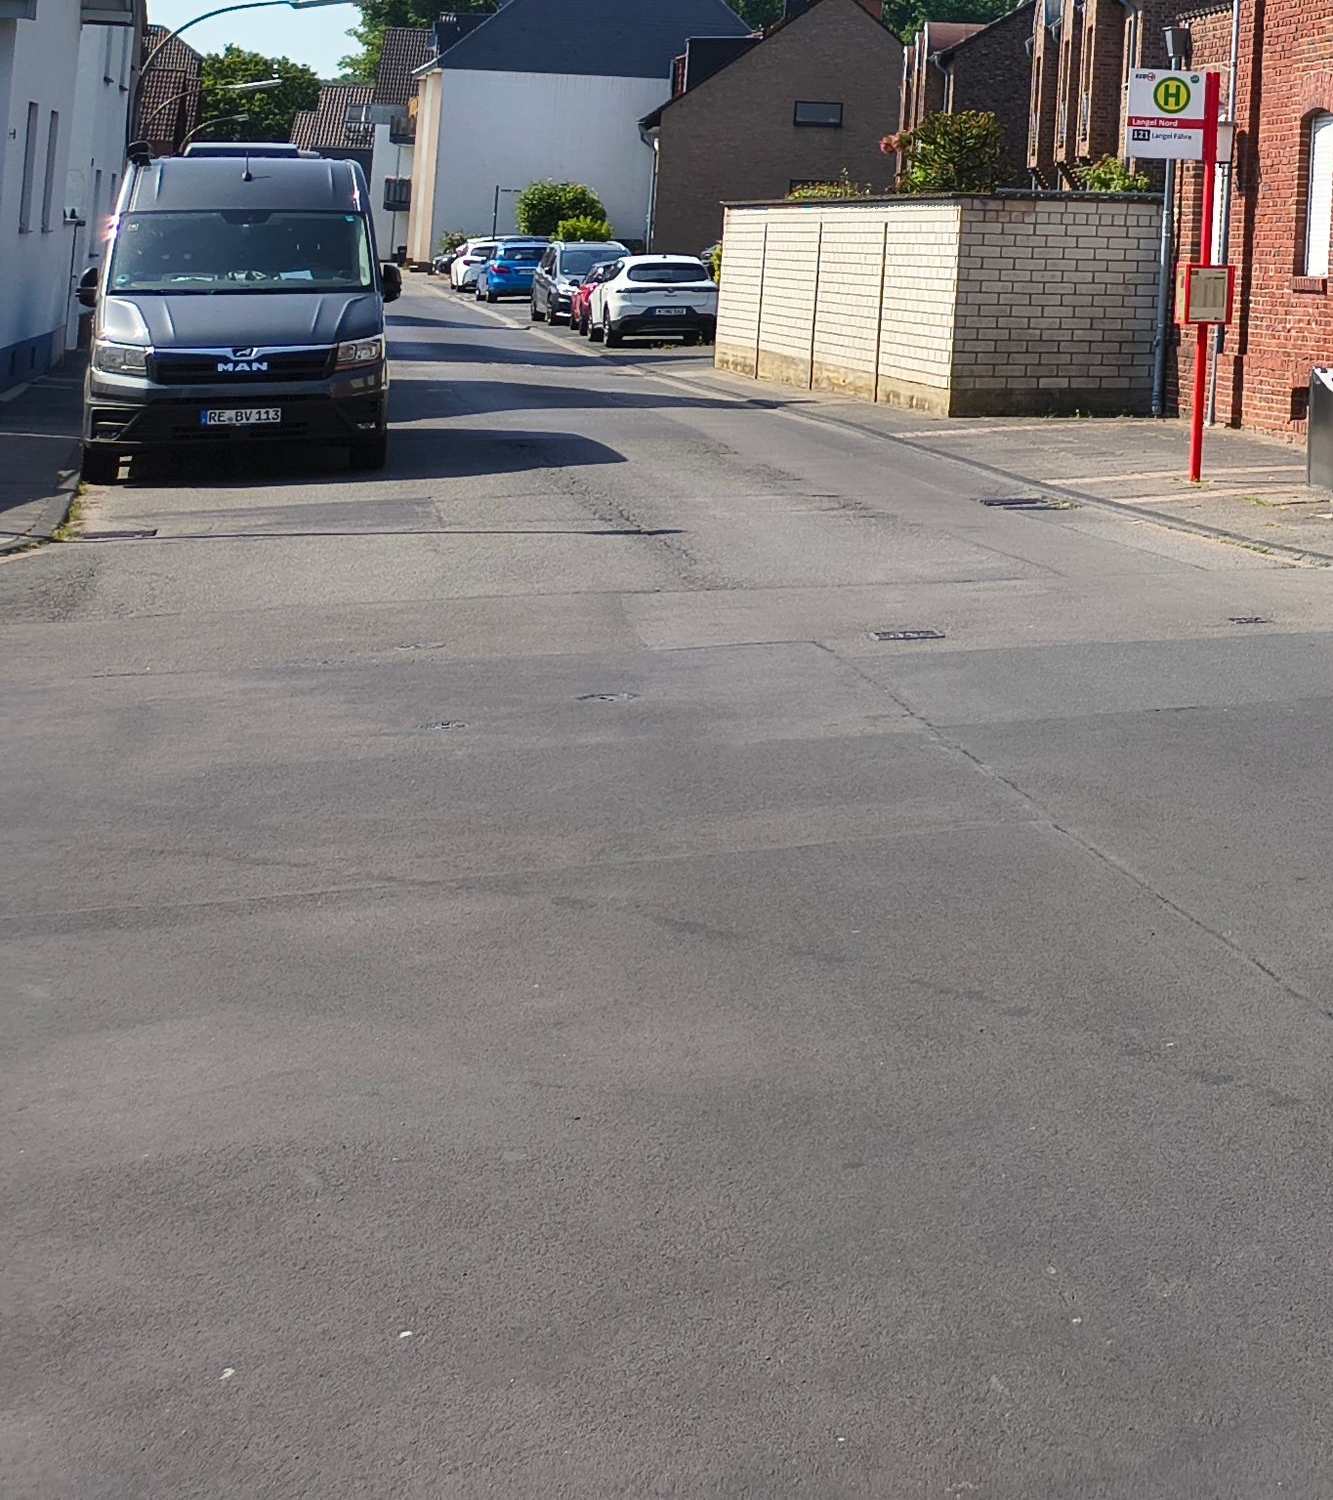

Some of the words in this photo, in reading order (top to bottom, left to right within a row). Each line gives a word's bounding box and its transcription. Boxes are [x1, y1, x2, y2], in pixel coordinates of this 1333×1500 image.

[1164, 84, 1181, 106] H
[1132, 118, 1157, 127] Langel
[1133, 130, 1149, 139] 121
[1152, 132, 1172, 140] Langel
[217, 362, 268, 372] MAN
[209, 411, 226, 423] RE
[235, 410, 252, 422] BV
[255, 409, 280, 421] 113
